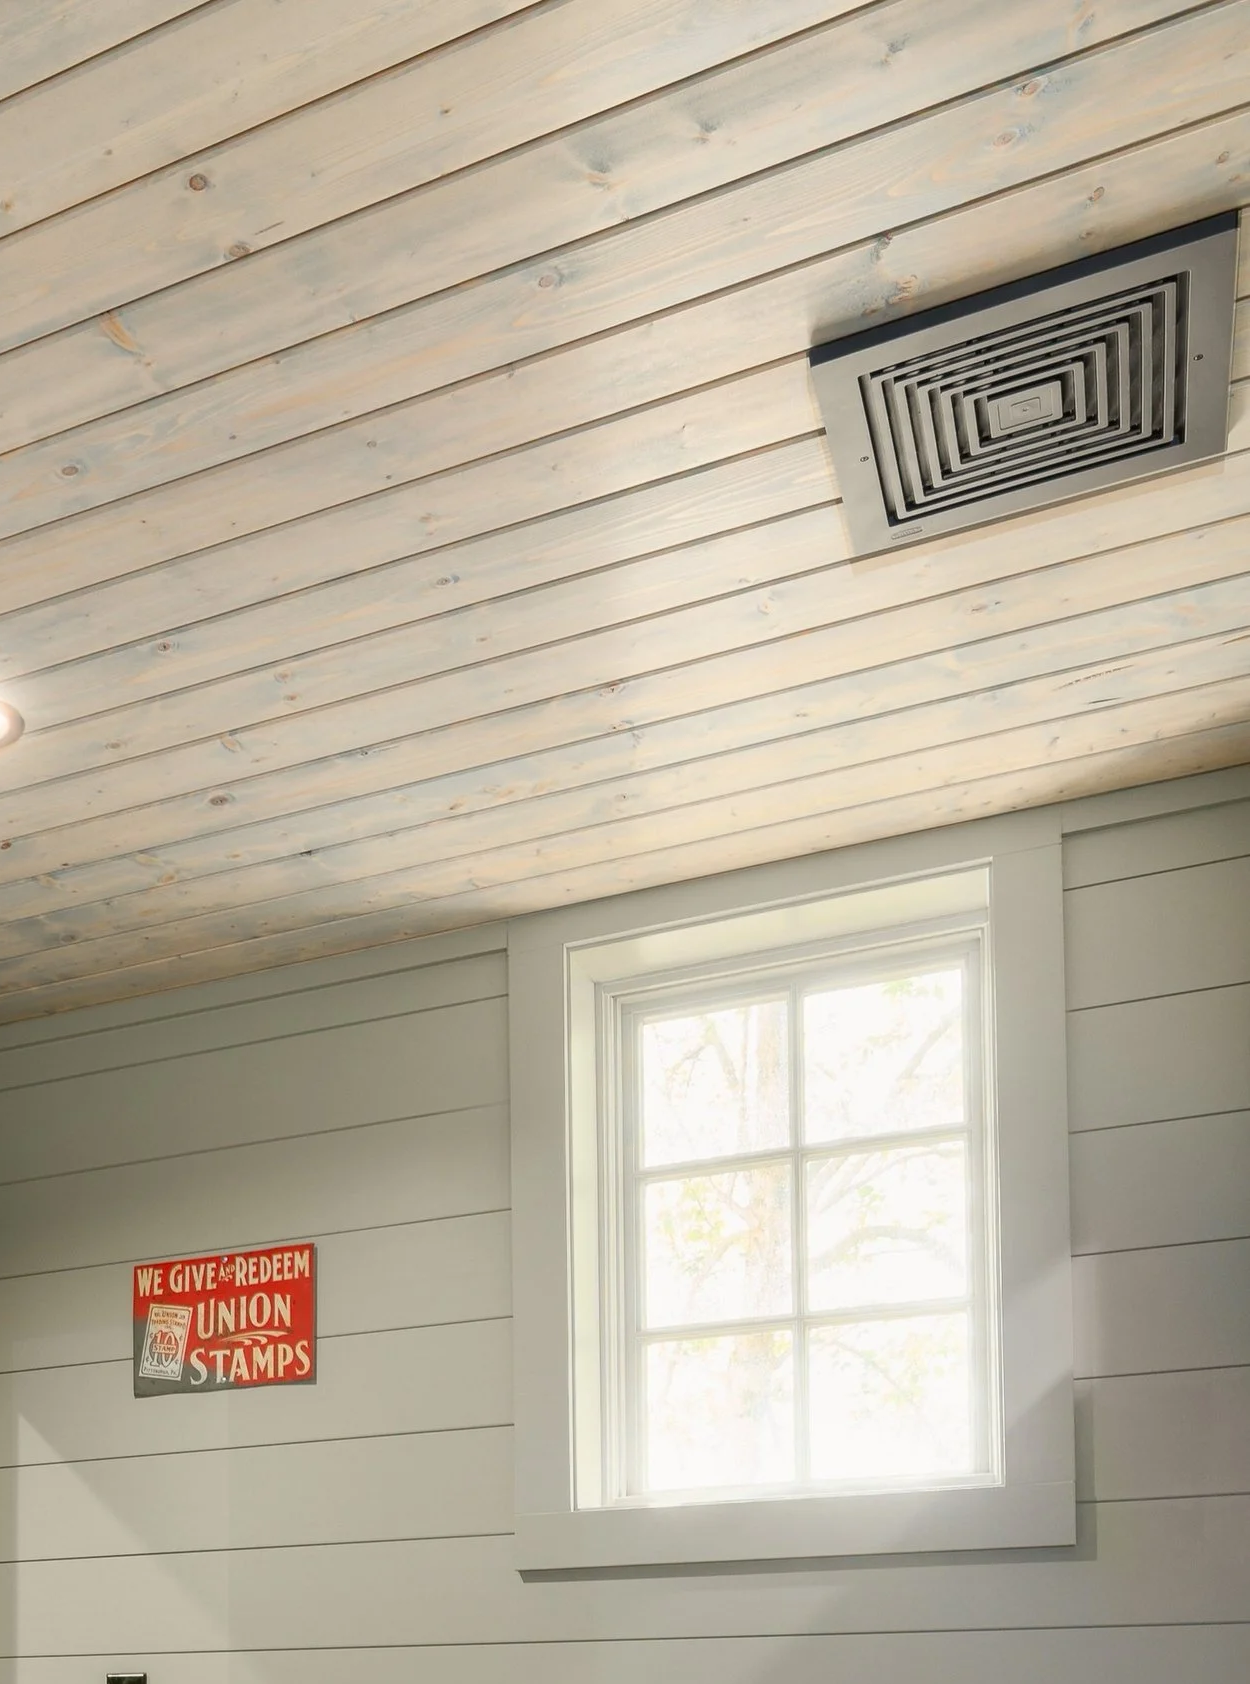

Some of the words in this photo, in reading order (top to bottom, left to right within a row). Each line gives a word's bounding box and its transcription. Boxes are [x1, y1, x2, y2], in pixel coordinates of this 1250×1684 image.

[137, 1267, 163, 1297] WE
[169, 1262, 217, 1293] GIVE
[218, 1262, 236, 1282] AND
[235, 1249, 310, 1287] REDEEM
[196, 1292, 292, 1340] UNION
[153, 1344, 176, 1353] STAMP
[189, 1340, 311, 1385] STAMPS
